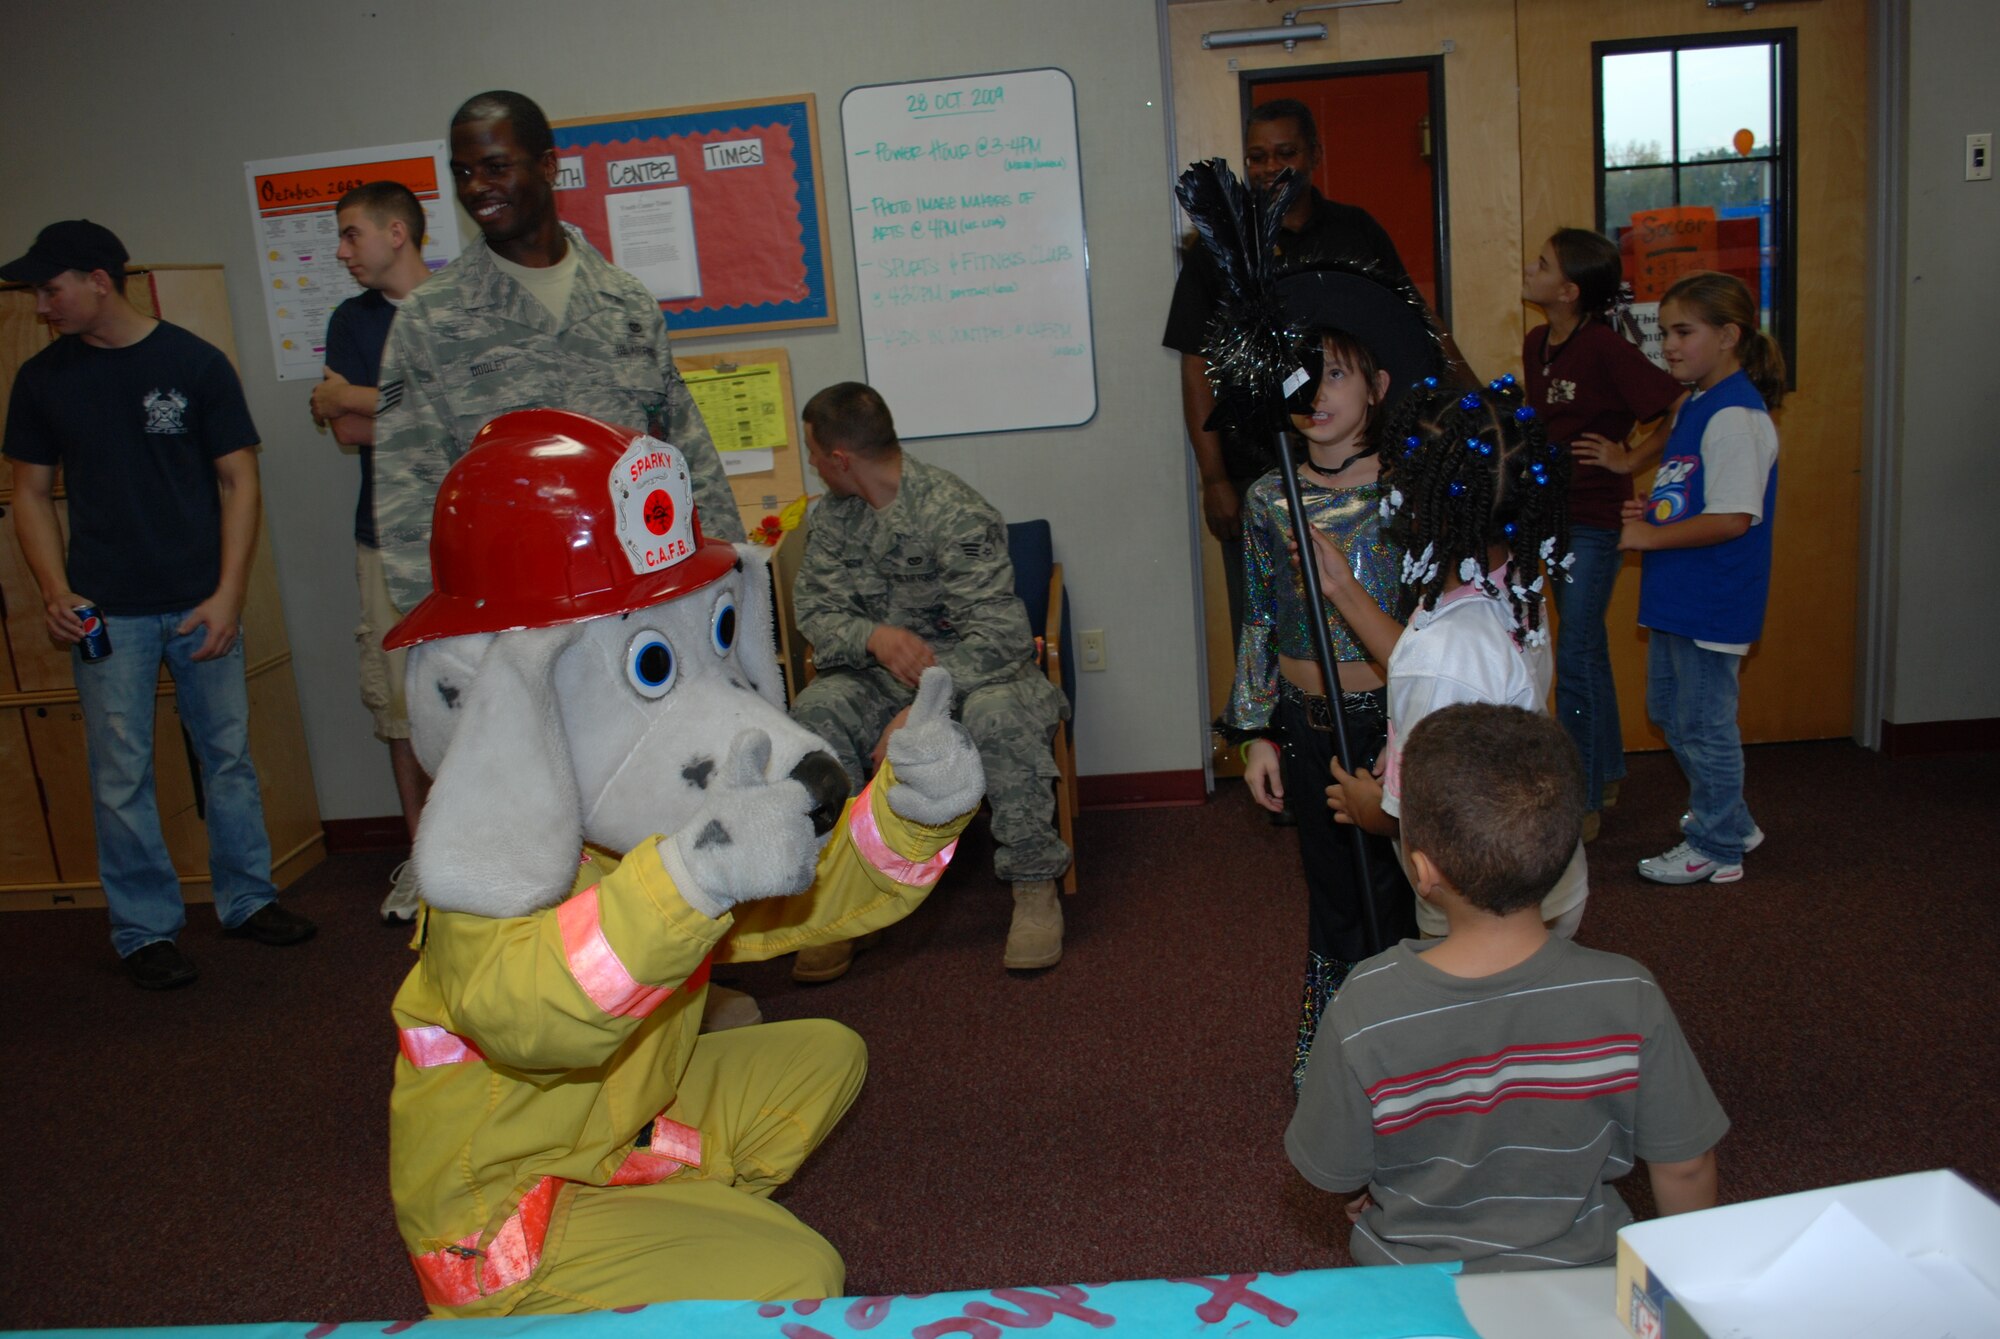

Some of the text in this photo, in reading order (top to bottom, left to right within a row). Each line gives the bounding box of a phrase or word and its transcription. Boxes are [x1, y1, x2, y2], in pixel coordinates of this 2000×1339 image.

[906, 86, 1004, 113] 28 OCT 2009
[871, 196, 912, 217] PHOTO
[630, 452, 672, 482] SPARKY
